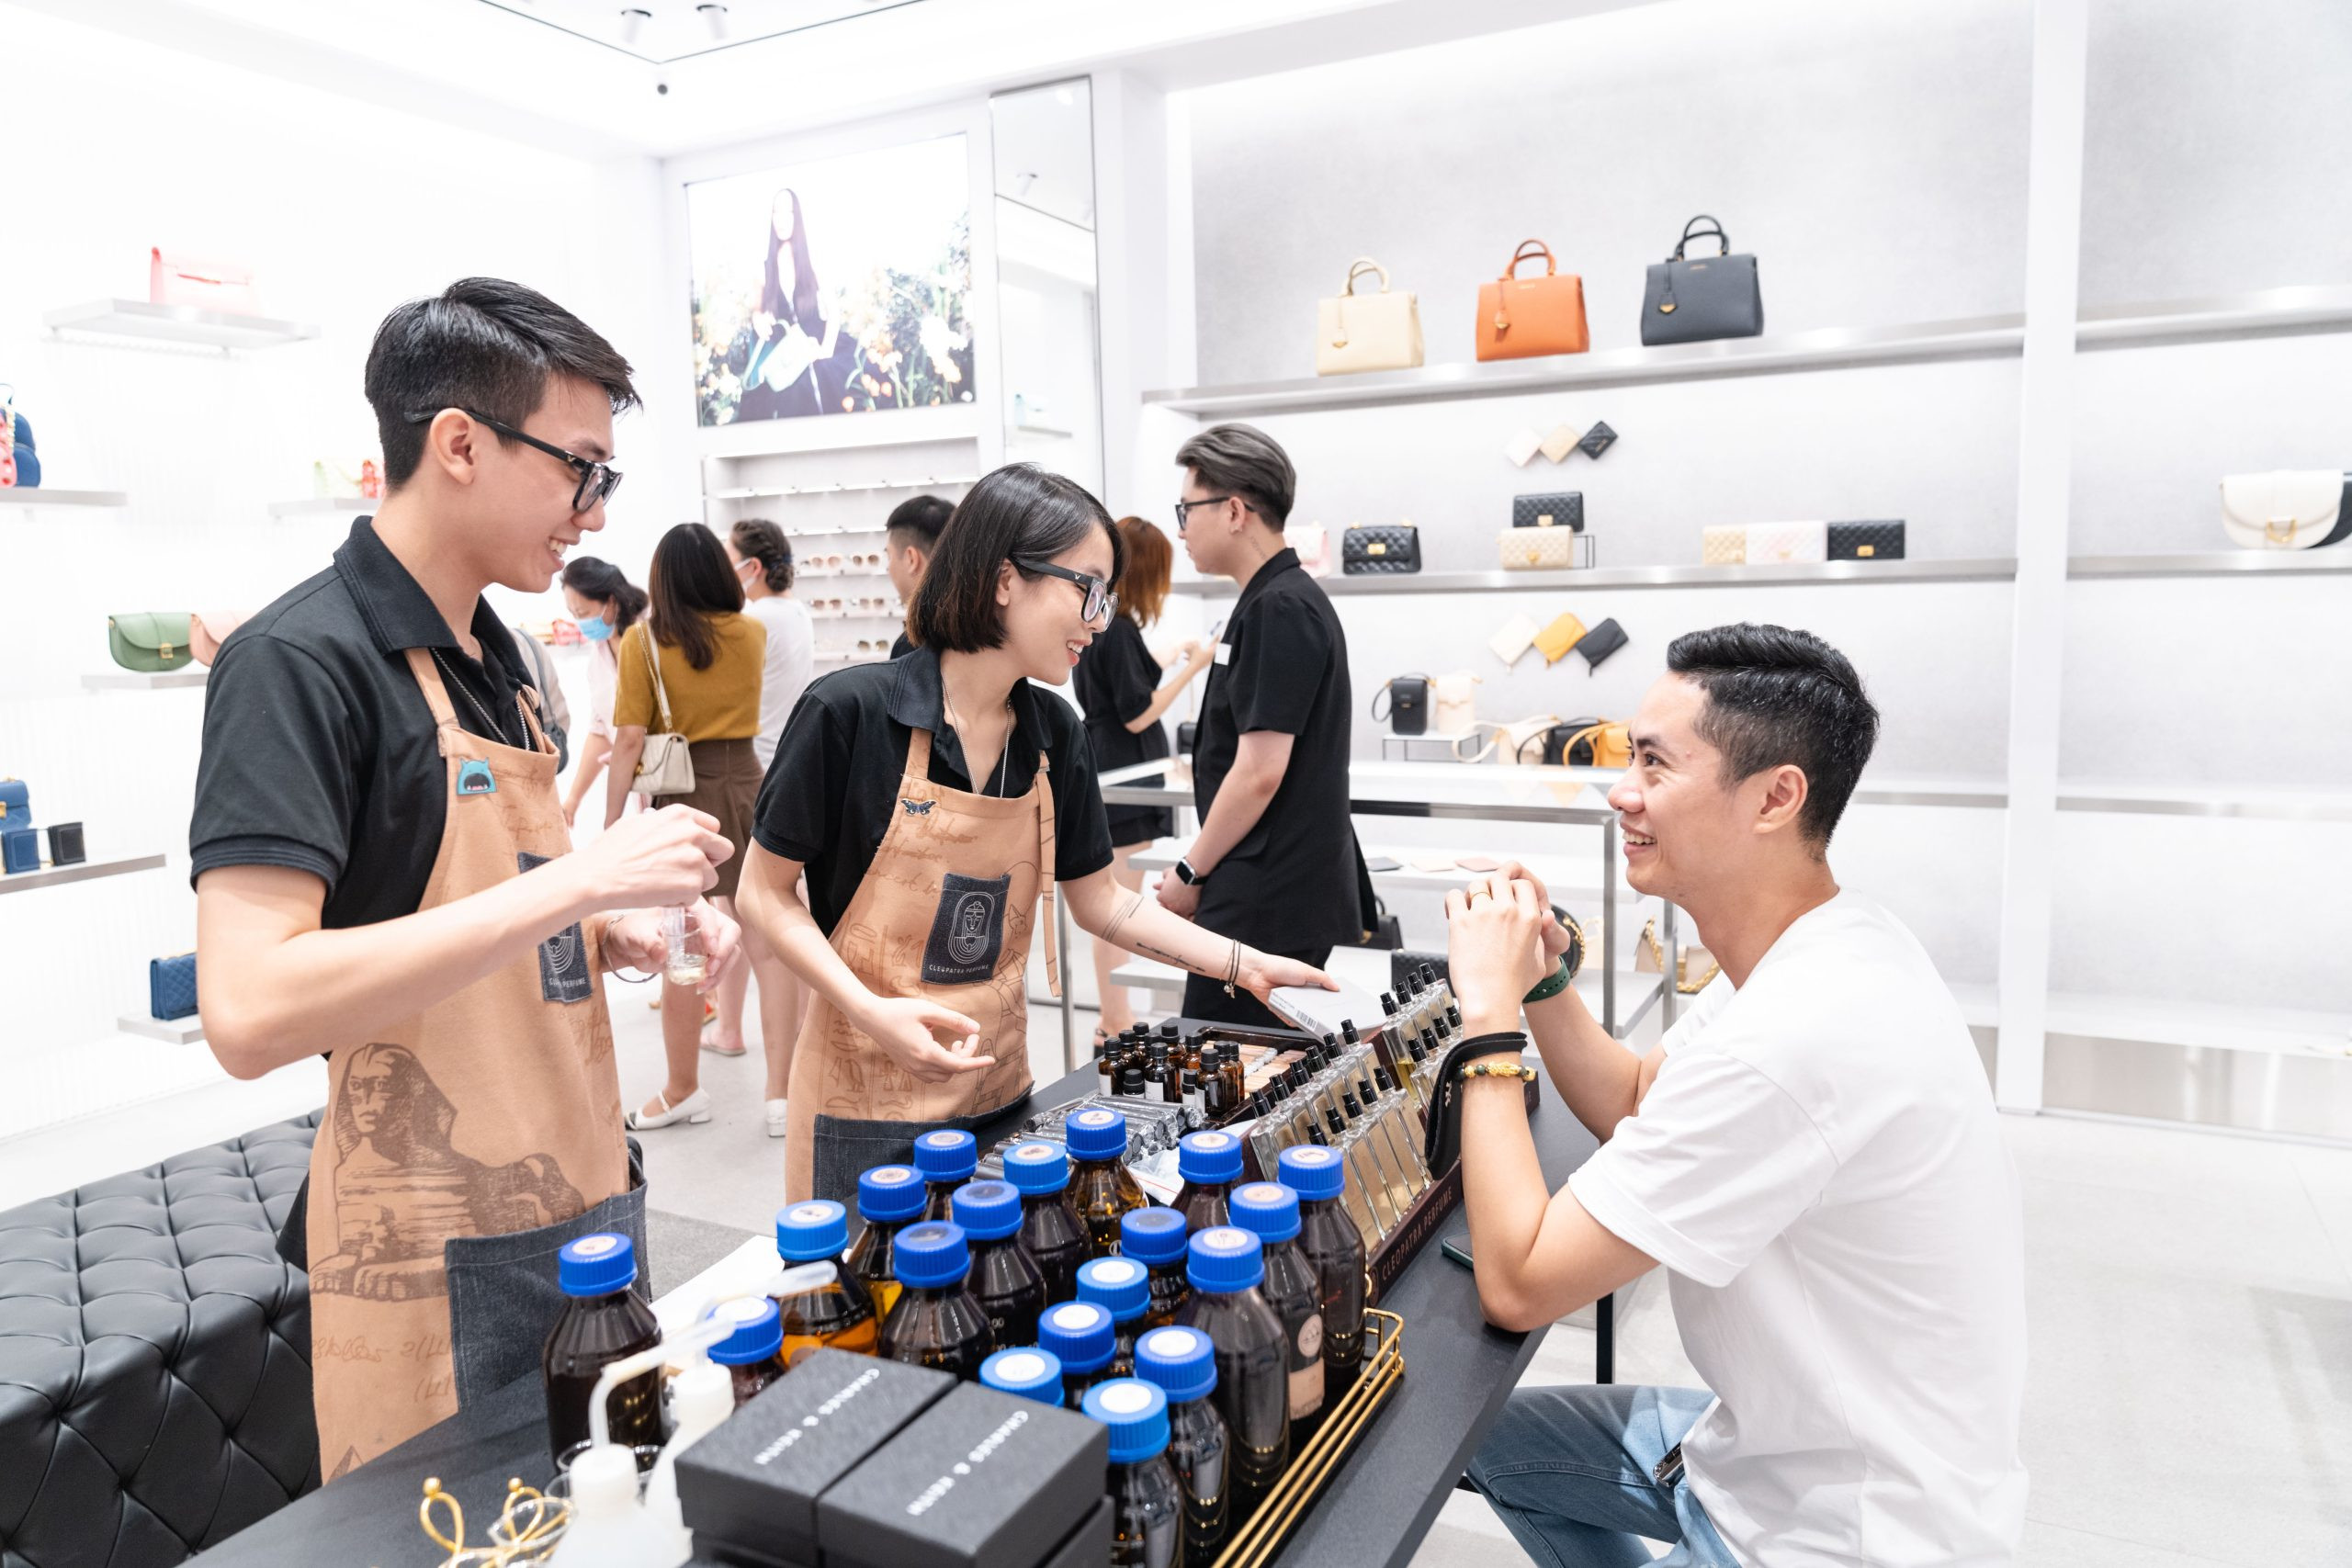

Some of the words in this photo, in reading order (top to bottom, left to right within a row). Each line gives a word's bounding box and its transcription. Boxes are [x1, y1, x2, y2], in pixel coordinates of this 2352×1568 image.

[929, 964, 964, 974] CLEOPATRA
[966, 964, 989, 973] PERFUME
[1381, 1224, 1423, 1281] CLEOPATRA
[1423, 1186, 1453, 1230] PERFUME
